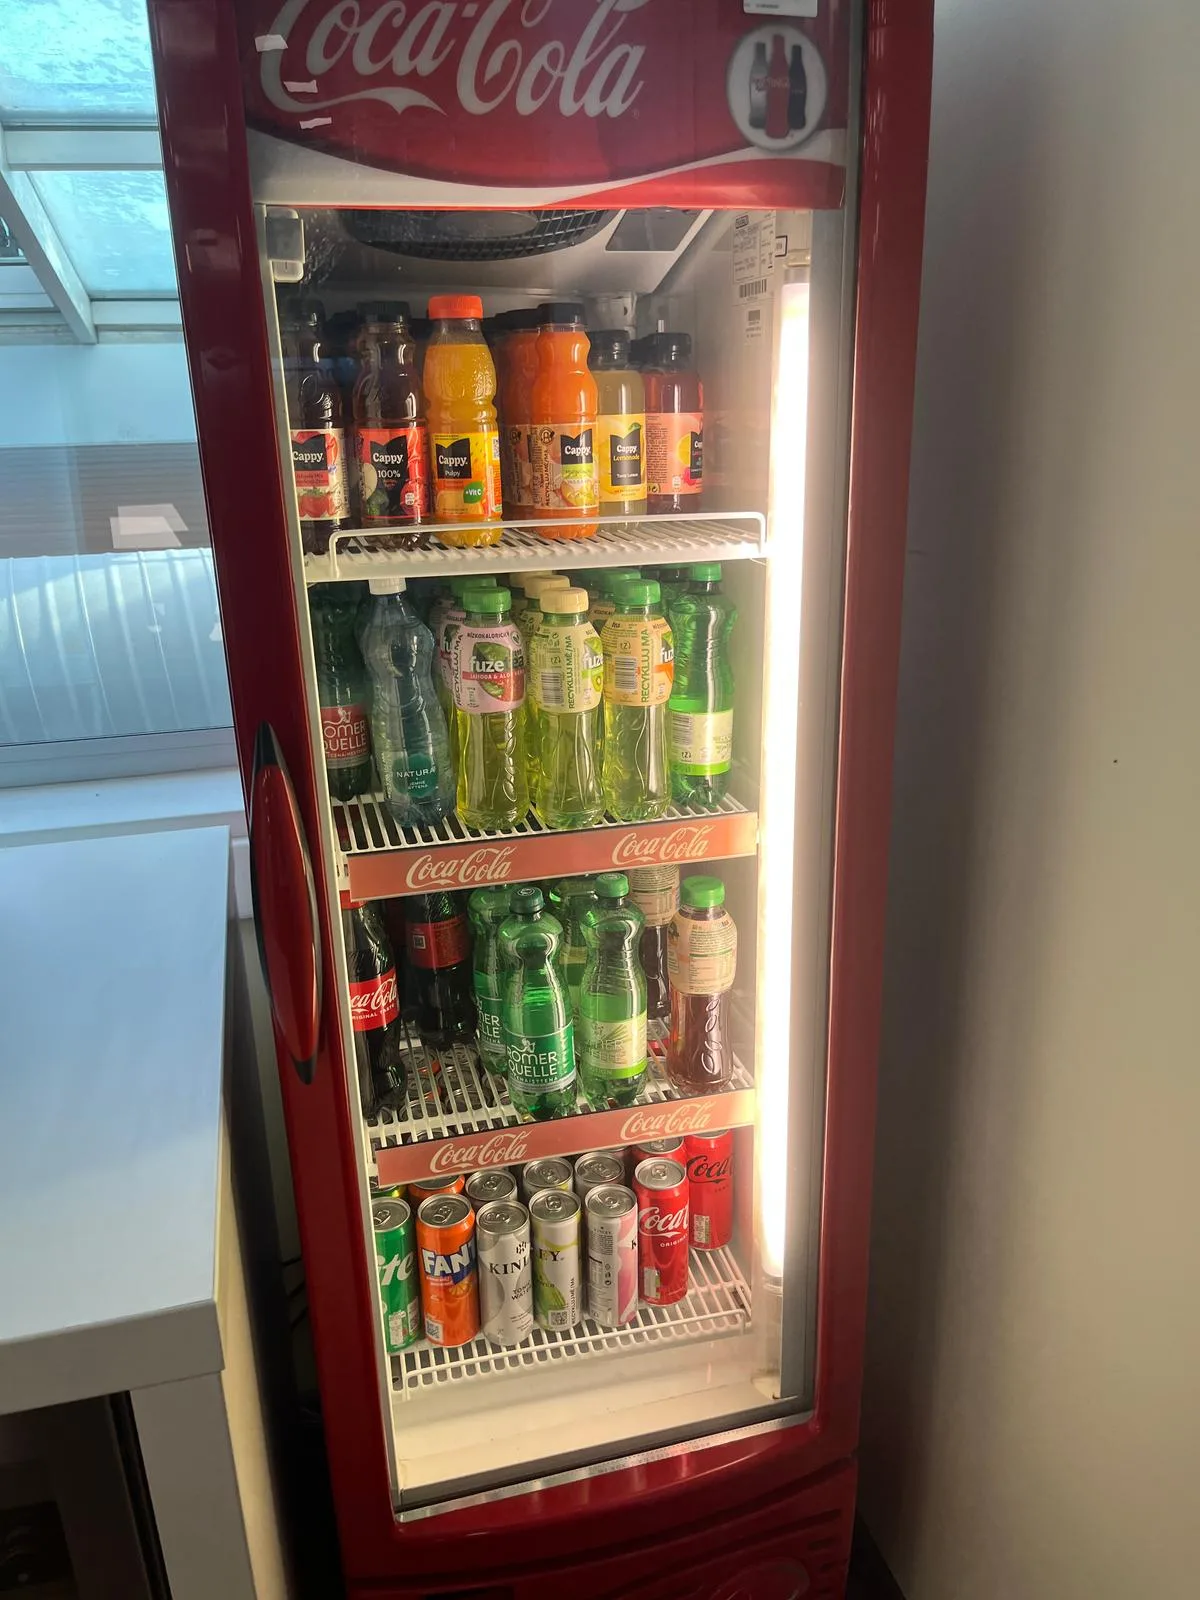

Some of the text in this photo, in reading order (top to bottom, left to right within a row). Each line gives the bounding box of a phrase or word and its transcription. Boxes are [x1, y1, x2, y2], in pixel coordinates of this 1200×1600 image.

[260, 0, 645, 118] Coca-Cola
[292, 451, 324, 463] Cappy
[373, 453, 403, 464] Cappy
[565, 446, 591, 457] Cappy
[617, 445, 637, 454] Cappy
[439, 455, 467, 466] Cappy
[378, 470, 400, 478] 100%
[470, 655, 504, 673] fuze
[641, 629, 650, 703] RECYKLUJ MA
[566, 667, 575, 709] RECYKLUJ
[324, 720, 365, 738] OMER
[612, 825, 716, 865] Coca-Cola
[406, 846, 517, 889] Coca-Cola
[351, 972, 397, 1010] ca-Cola
[352, 1012, 377, 1020] RIGINAL
[509, 1060, 557, 1077] QUELLE
[620, 1101, 716, 1141] Coca-Cola
[430, 1128, 536, 1173] Coca-Cola
[422, 1243, 473, 1277] FAN
[490, 1257, 528, 1275] KINL
